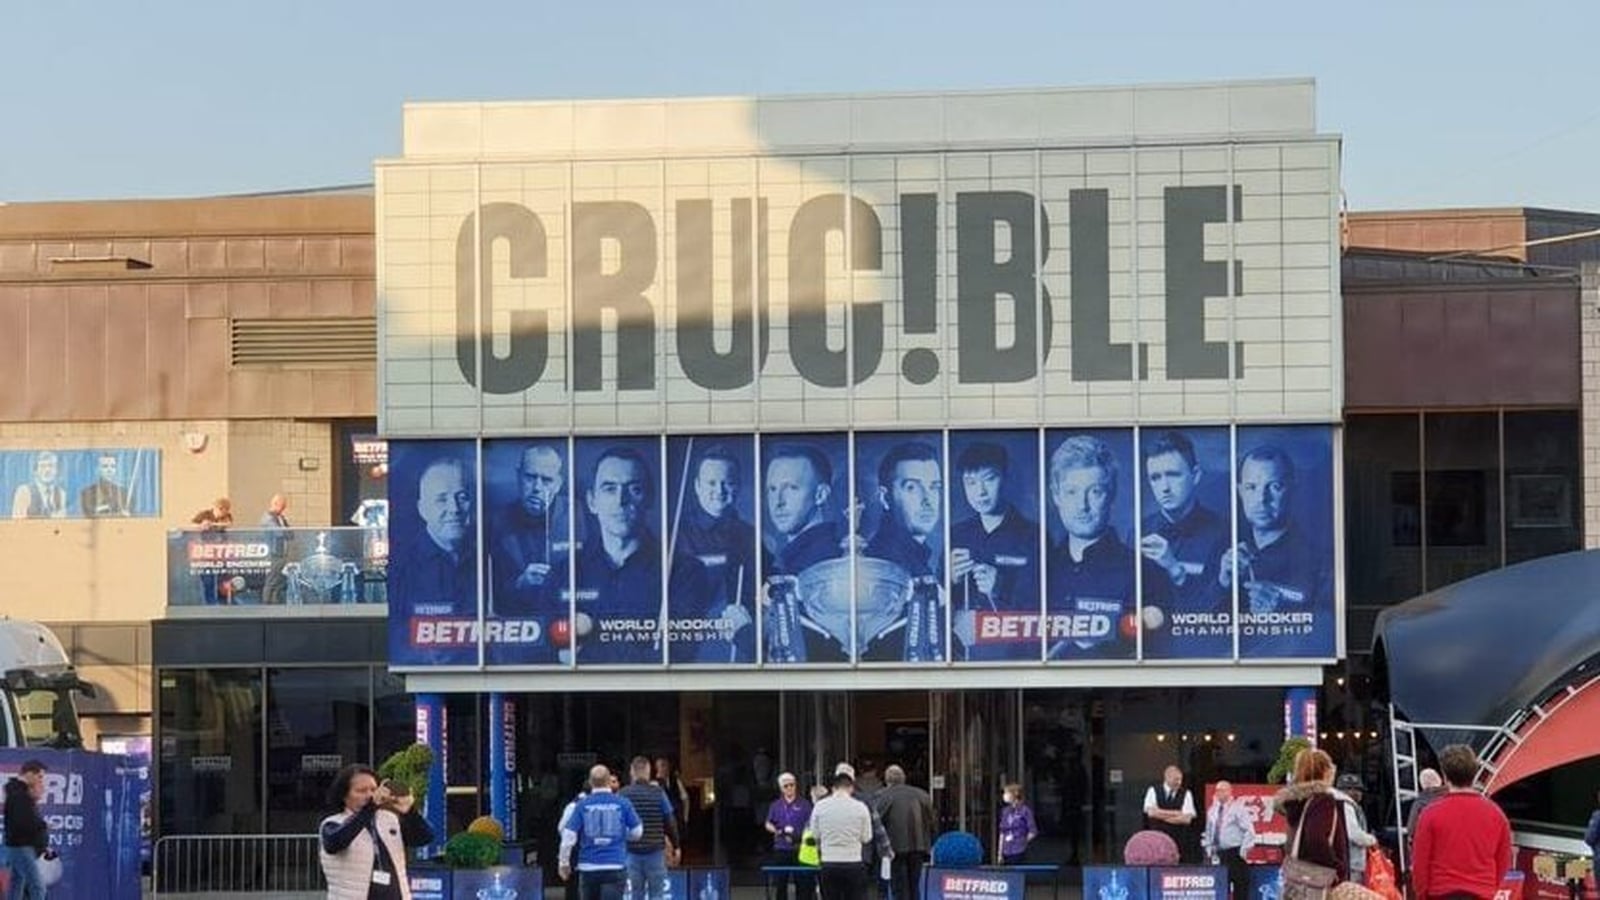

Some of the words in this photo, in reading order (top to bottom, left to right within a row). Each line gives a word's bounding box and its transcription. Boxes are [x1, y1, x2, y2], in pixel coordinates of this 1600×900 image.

[455, 184, 1244, 395] CRUC!BLE
[191, 543, 269, 558] BETFRED
[1171, 613, 1230, 624] WORLD
[600, 619, 657, 631] WORLD
[661, 619, 734, 631] NOOKER
[1171, 626, 1313, 636] CHAMPONSHIP
[600, 632, 734, 642] CHAMPONSHIP
